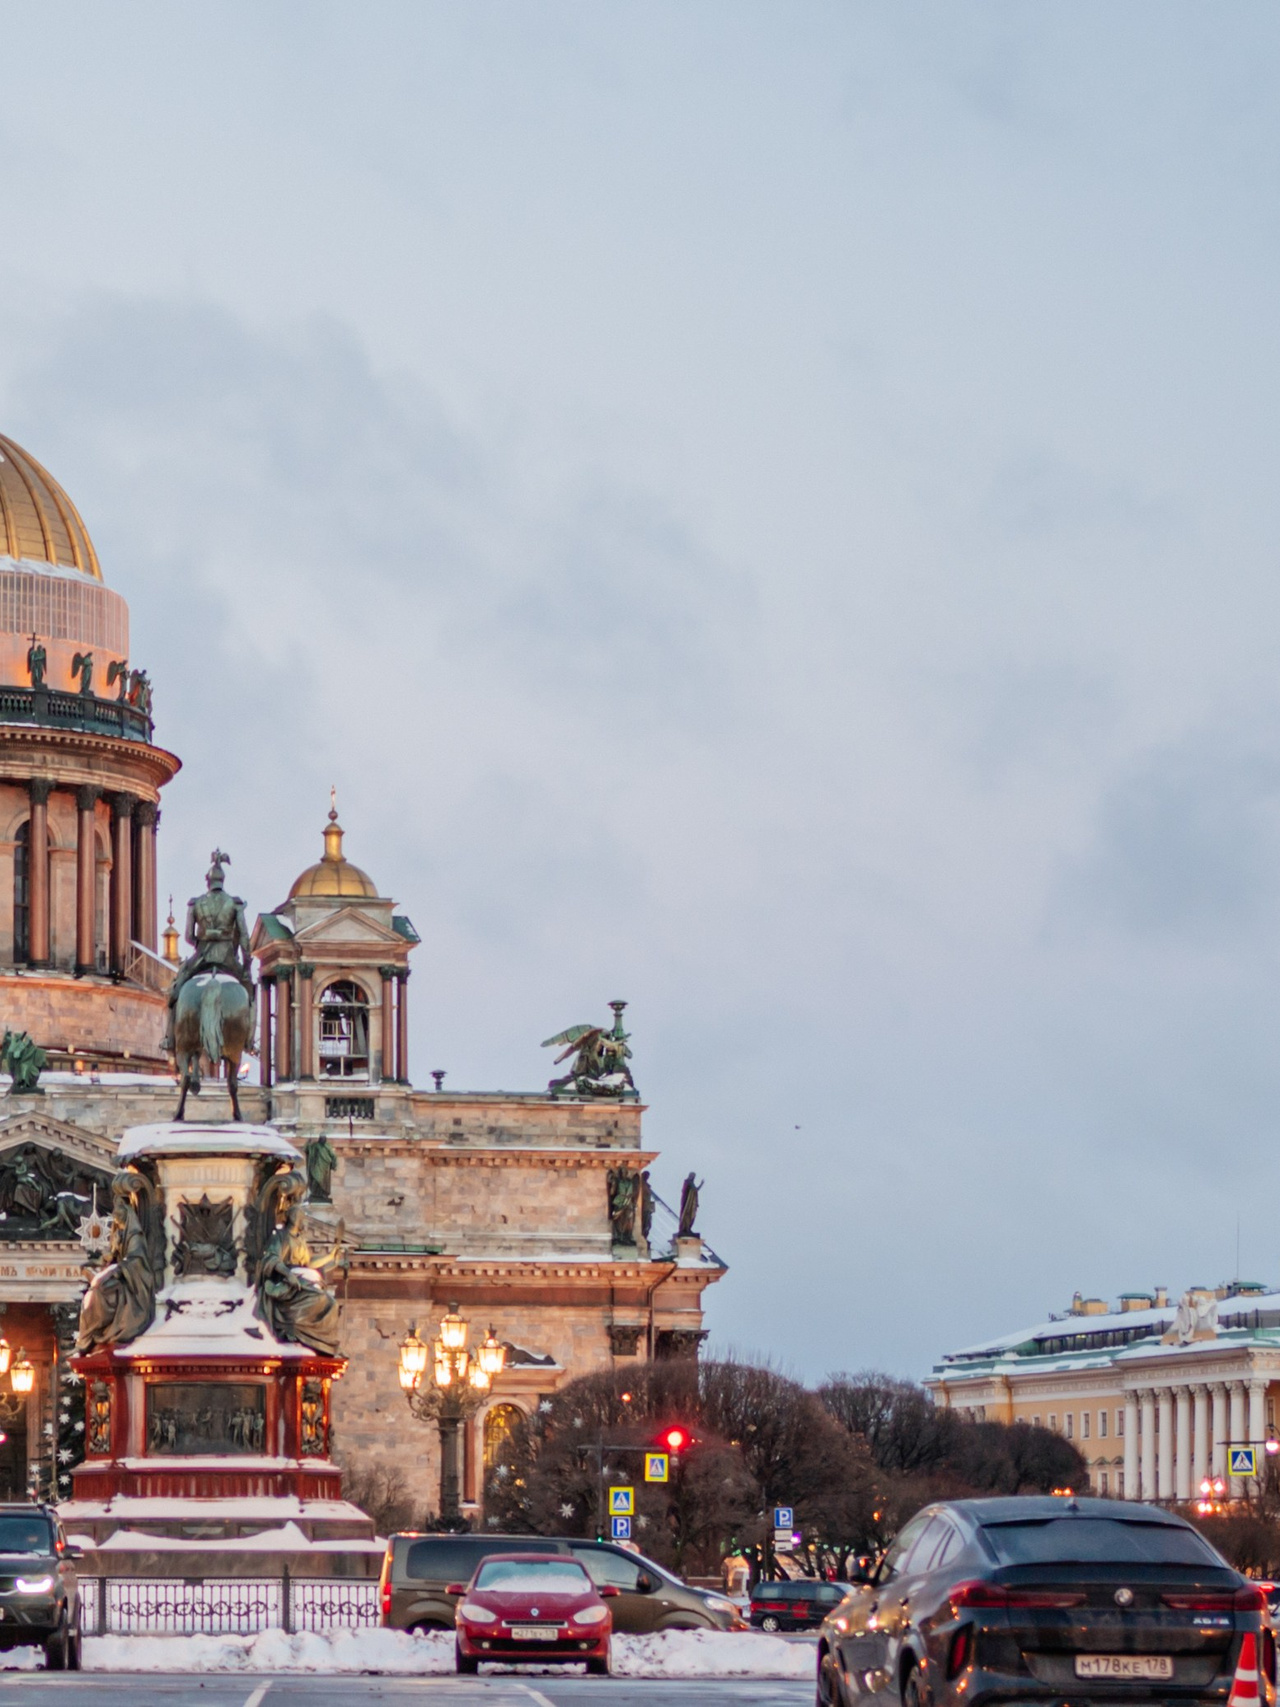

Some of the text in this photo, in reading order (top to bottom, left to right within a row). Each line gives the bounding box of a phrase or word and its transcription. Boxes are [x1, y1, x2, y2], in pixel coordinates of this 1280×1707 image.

[780, 1511, 790, 1526] P
[617, 1519, 628, 1536] P
[1081, 1658, 1167, 1674] М178КЕ 178
